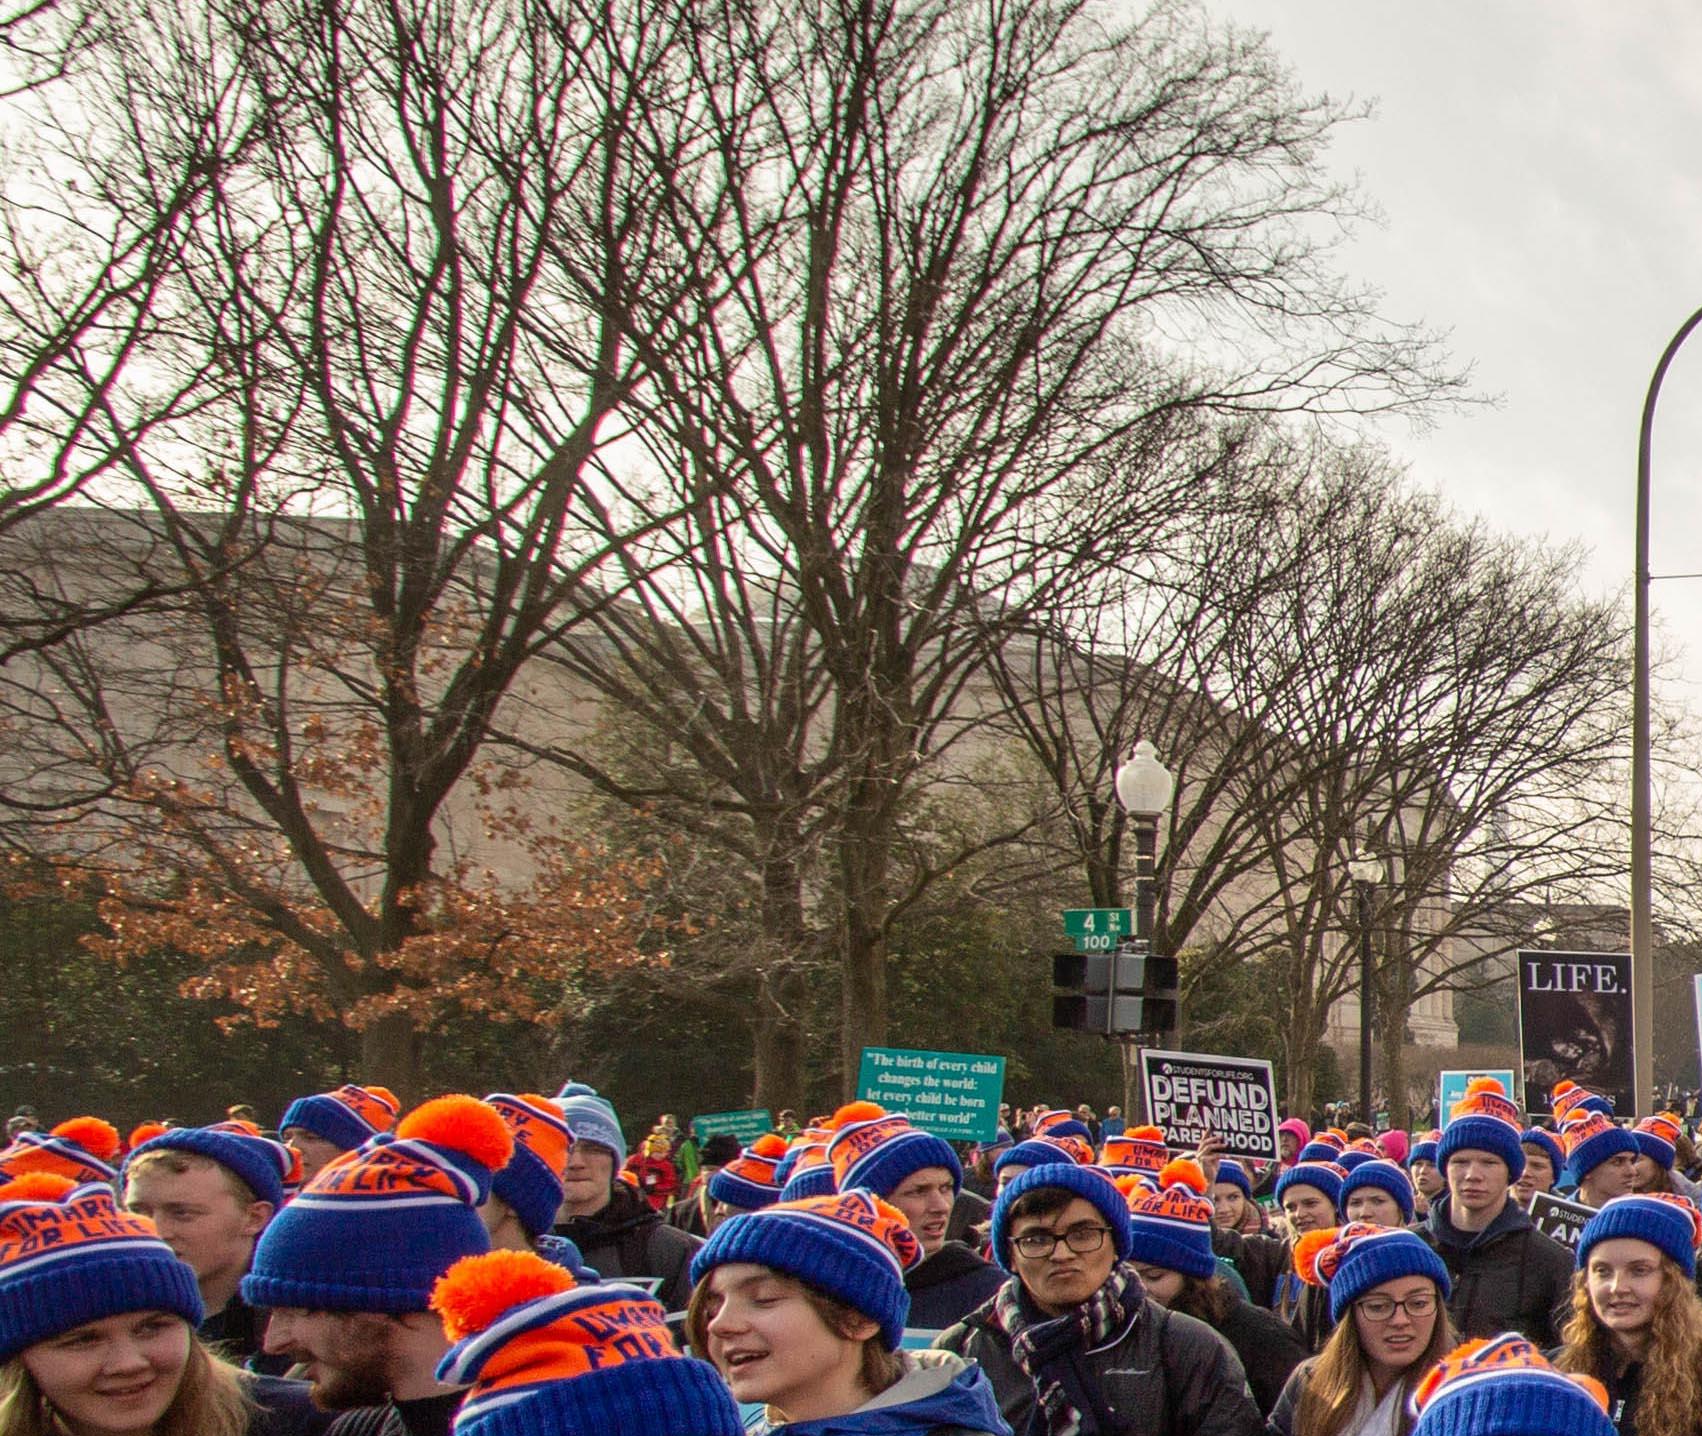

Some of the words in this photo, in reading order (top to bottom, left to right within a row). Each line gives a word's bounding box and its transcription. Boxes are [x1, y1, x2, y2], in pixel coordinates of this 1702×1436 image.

[1083, 912, 1096, 933] 4
[1083, 934, 1111, 950] 100
[1527, 961, 1628, 995] LIFE.
[925, 1057, 938, 1071] of
[877, 1071, 922, 1088] changes
[923, 1074, 940, 1088] the
[1150, 1074, 1269, 1111] DEFUND
[1153, 1102, 1271, 1134] PLANNED
[77, 1218, 150, 1241] LIFE
